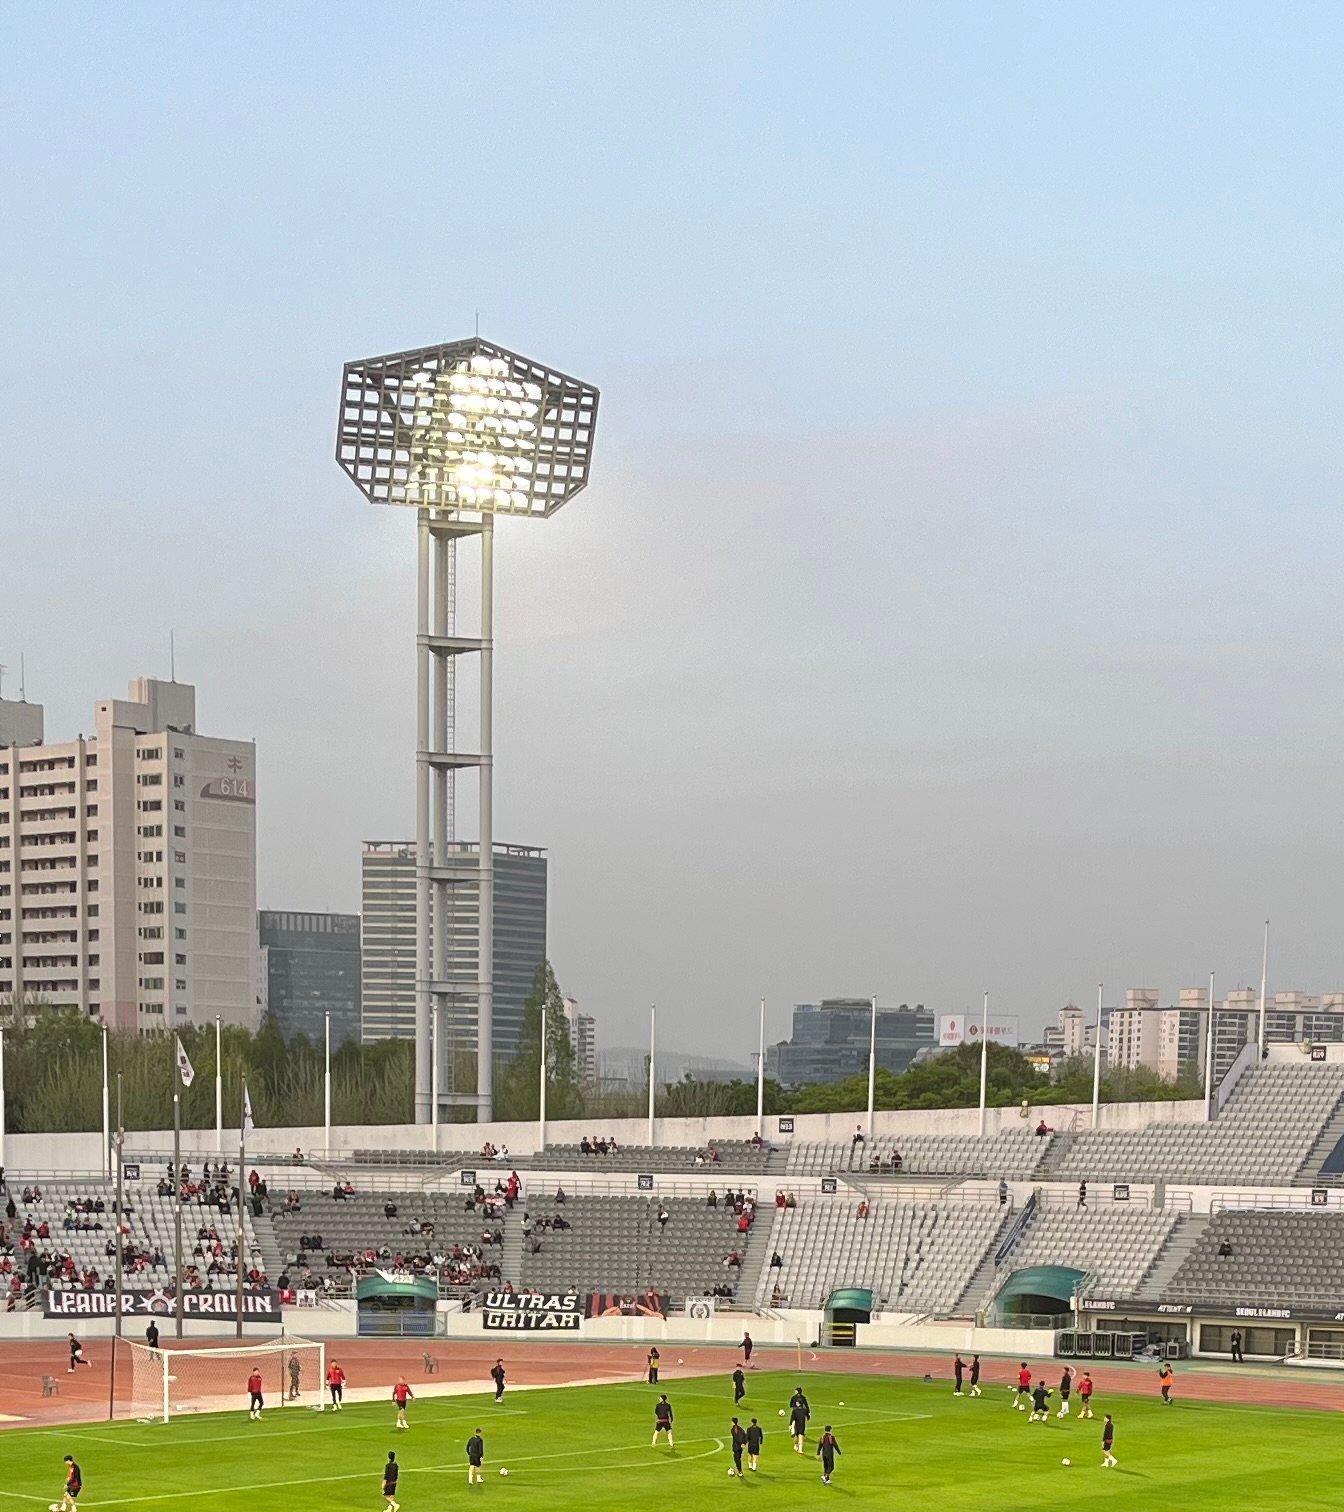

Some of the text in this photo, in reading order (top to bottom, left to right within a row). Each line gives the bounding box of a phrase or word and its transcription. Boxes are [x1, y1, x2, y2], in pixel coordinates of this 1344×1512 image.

[220, 778, 249, 797] 614
[485, 1293, 578, 1310] ULTRAS
[486, 1312, 580, 1329] GRITAR
